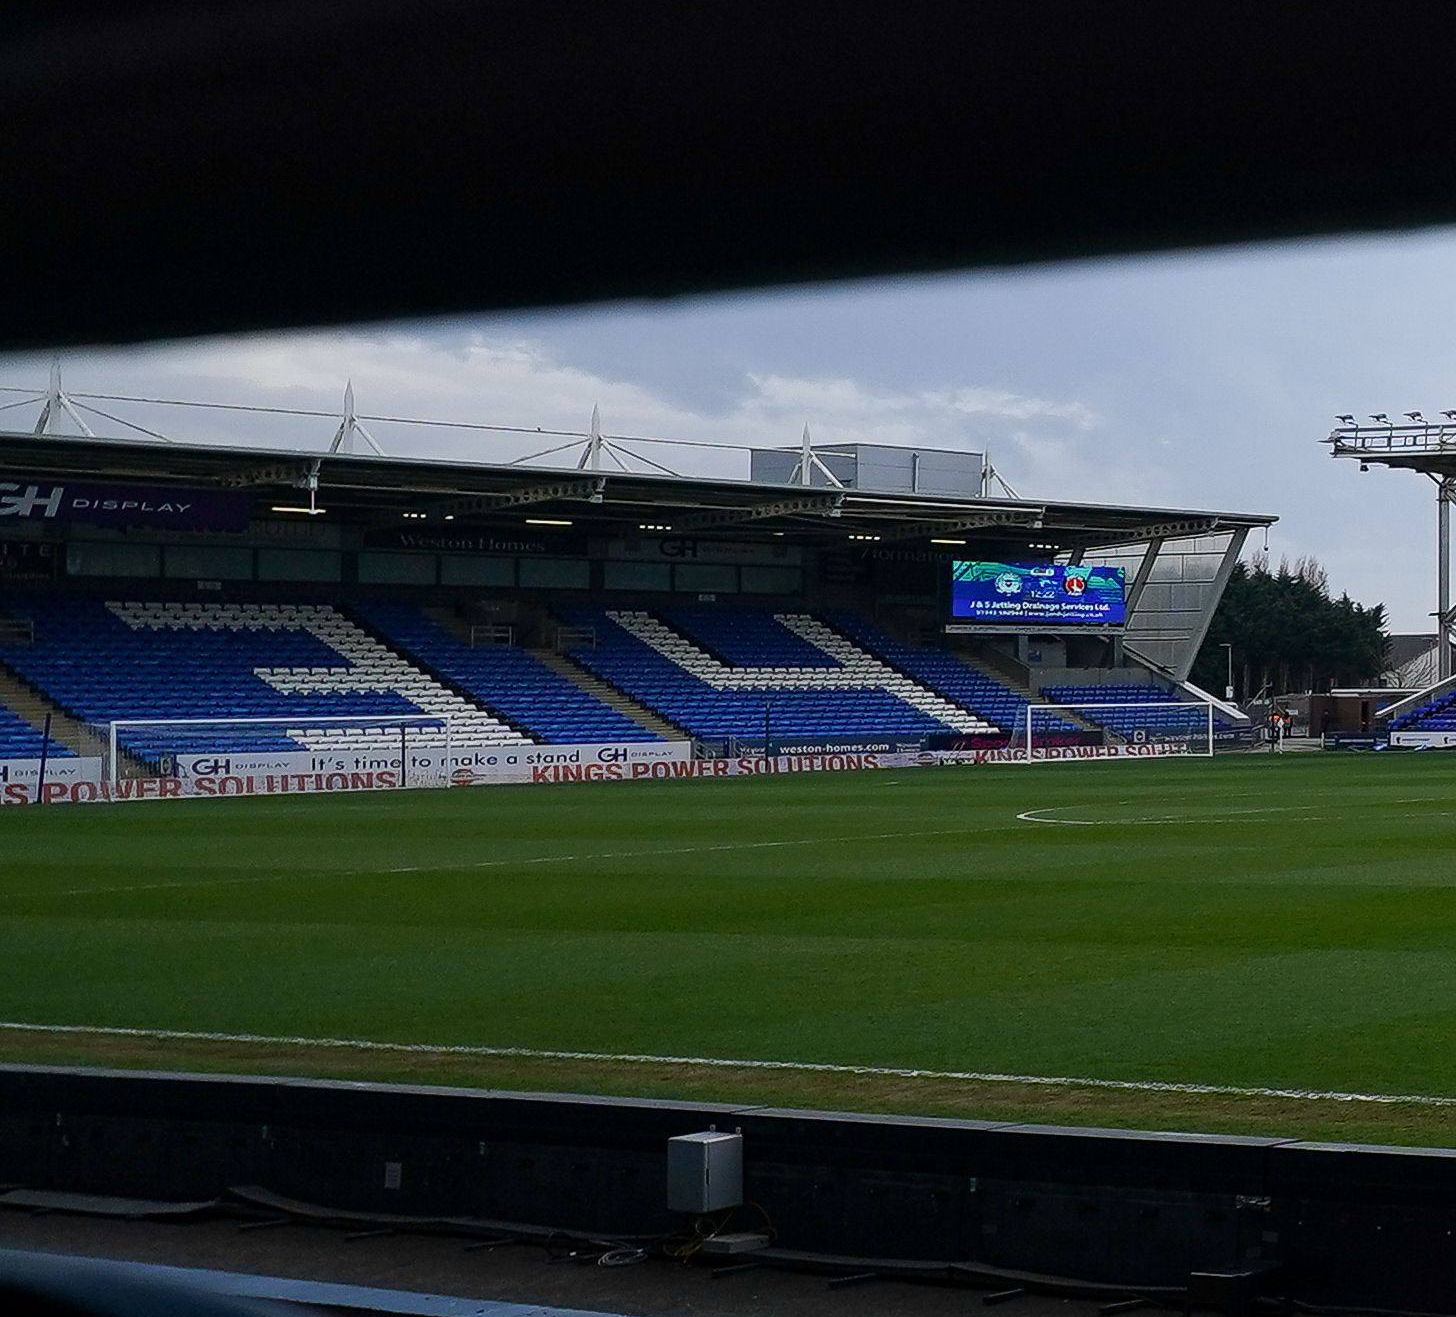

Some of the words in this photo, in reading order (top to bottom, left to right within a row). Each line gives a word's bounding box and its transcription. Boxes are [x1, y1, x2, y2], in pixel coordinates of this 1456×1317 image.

[72, 497, 192, 514] DISPLAY
[400, 534, 473, 550] Weston
[479, 536, 545, 552] Homes
[1061, 602, 1094, 612] Services
[597, 747, 628, 763] GH
[780, 742, 890, 755] weston-homes.com
[192, 758, 231, 775] GH
[311, 756, 345, 771] It's
[354, 755, 402, 770] time
[410, 754, 432, 768] to
[506, 754, 518, 765] a
[526, 749, 580, 764] stand
[532, 763, 623, 784] KINGS
[632, 758, 729, 780] POWER
